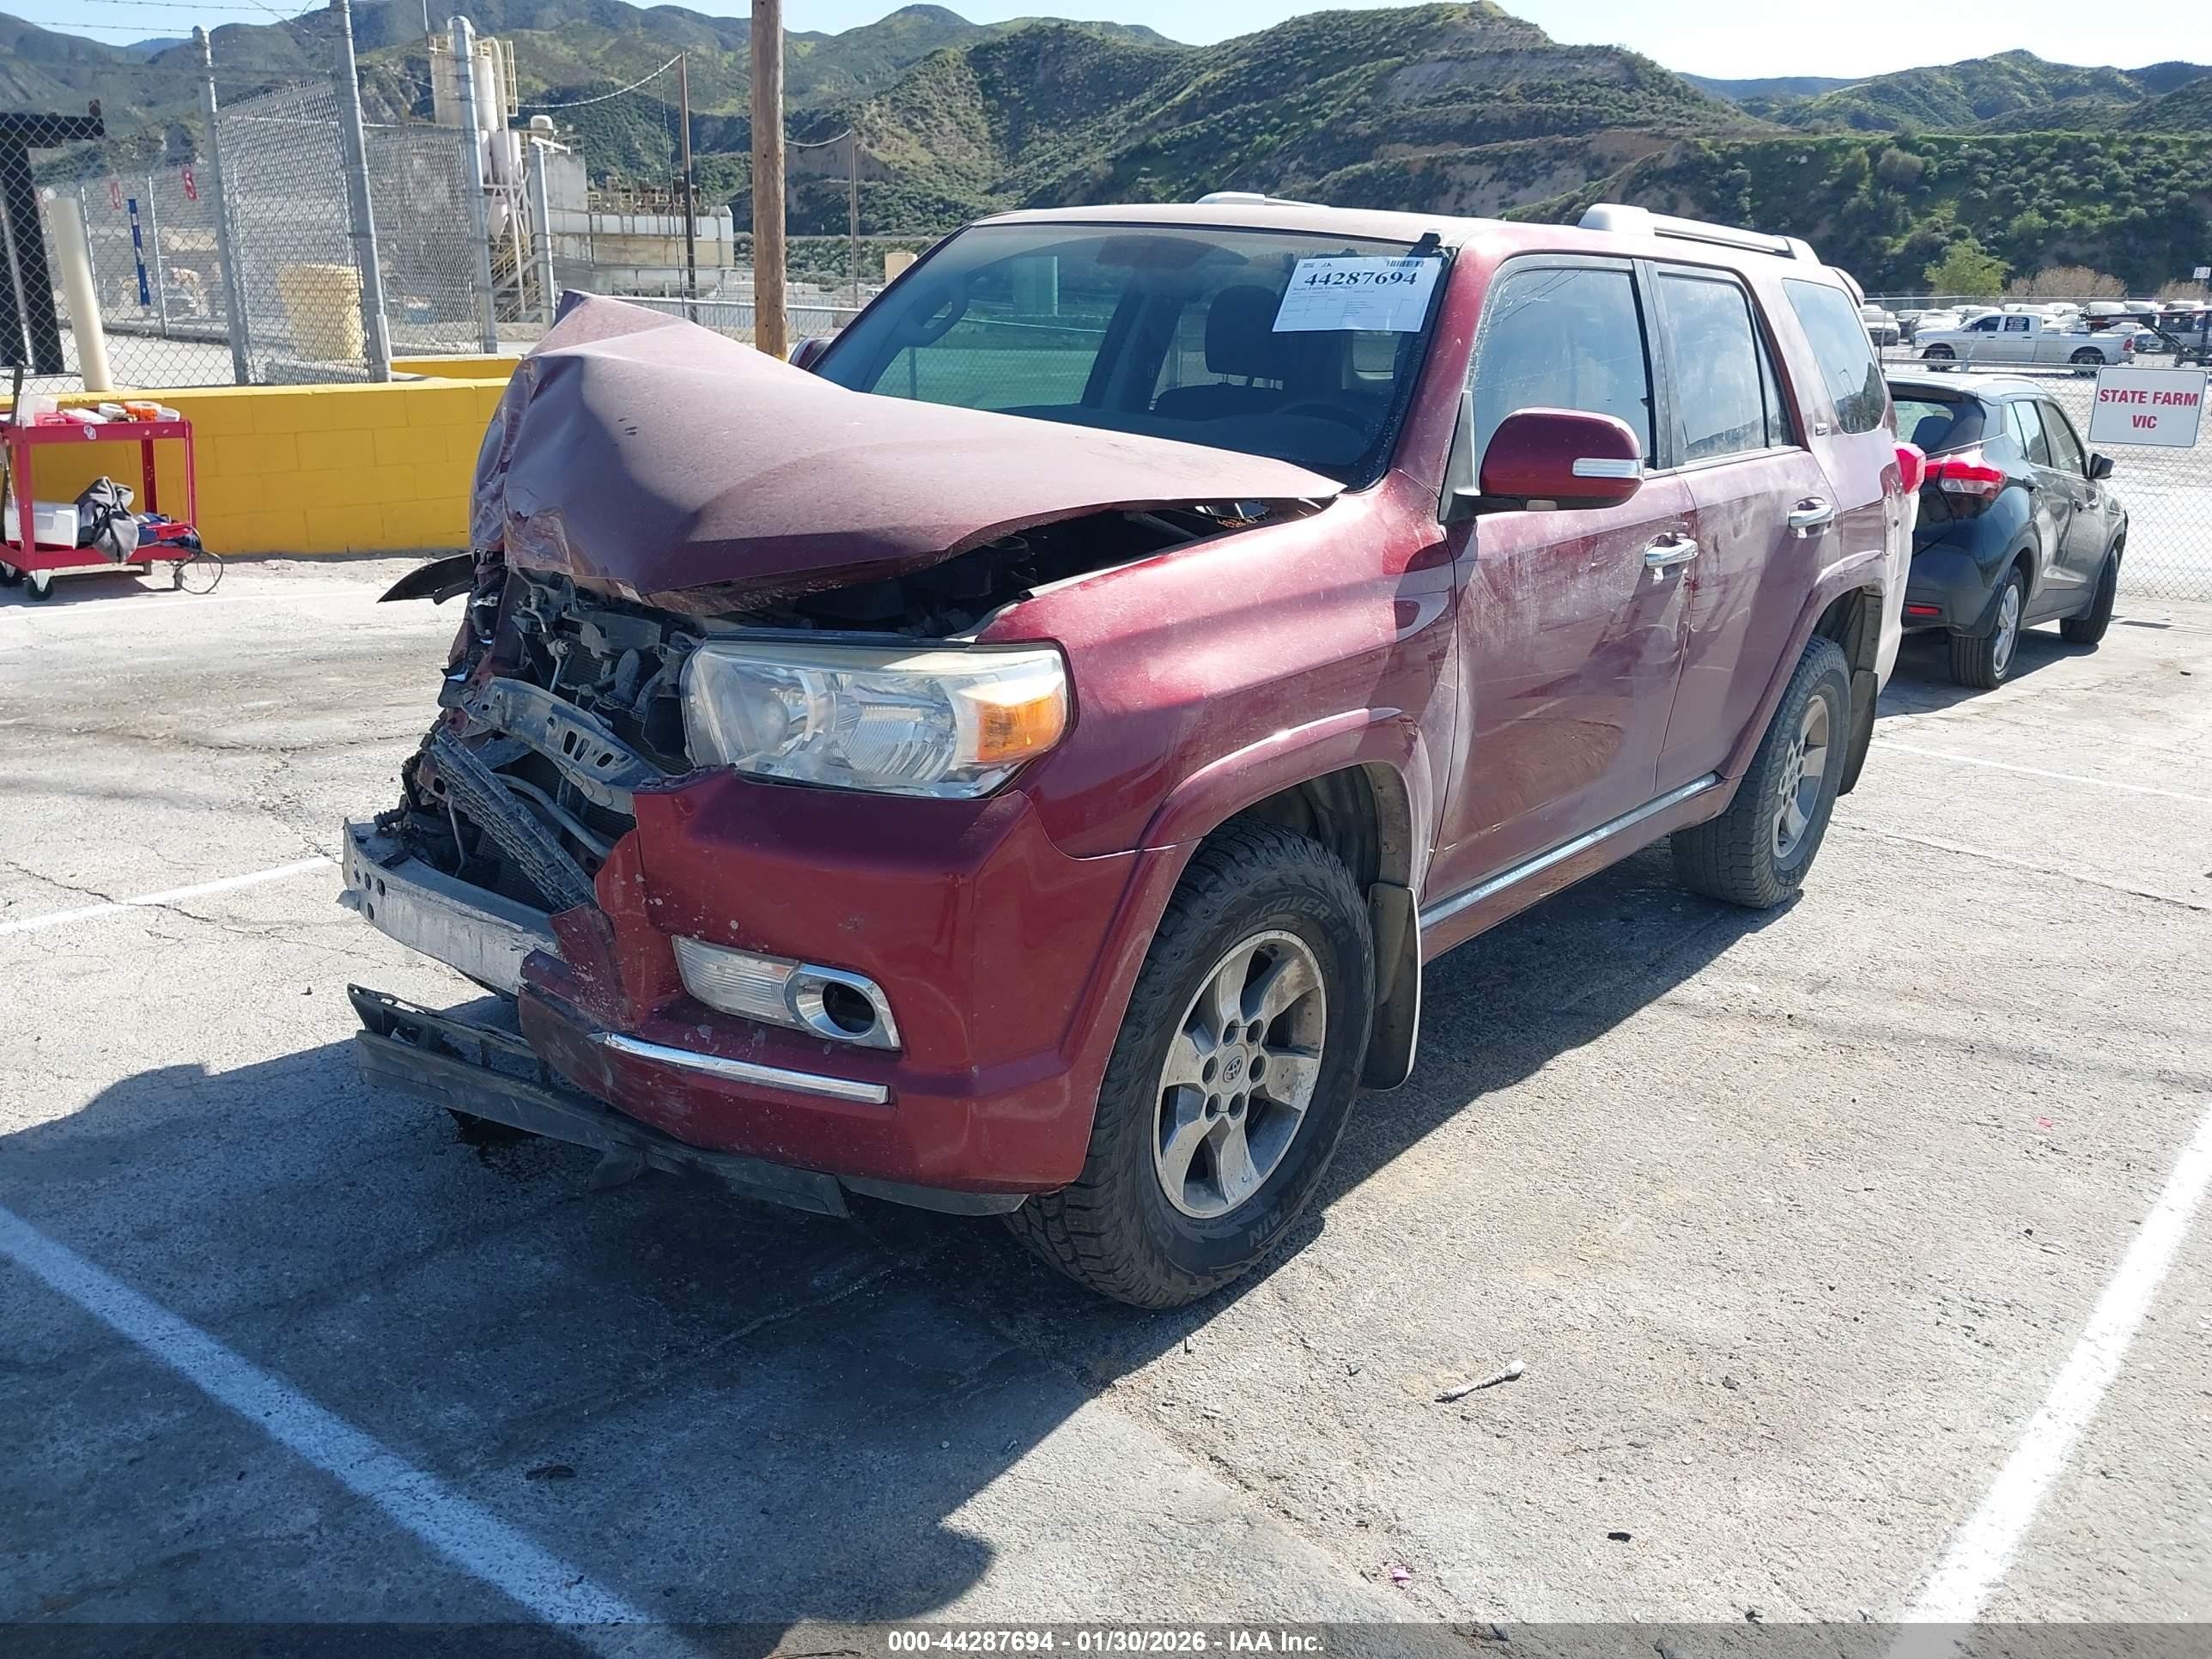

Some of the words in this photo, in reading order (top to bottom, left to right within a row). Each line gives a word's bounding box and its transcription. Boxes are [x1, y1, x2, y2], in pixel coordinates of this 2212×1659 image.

[1304, 270, 1418, 286] 44287694
[2099, 389, 2148, 404] STATE
[2152, 391, 2199, 407] FARM
[2132, 415, 2158, 429] VIC
